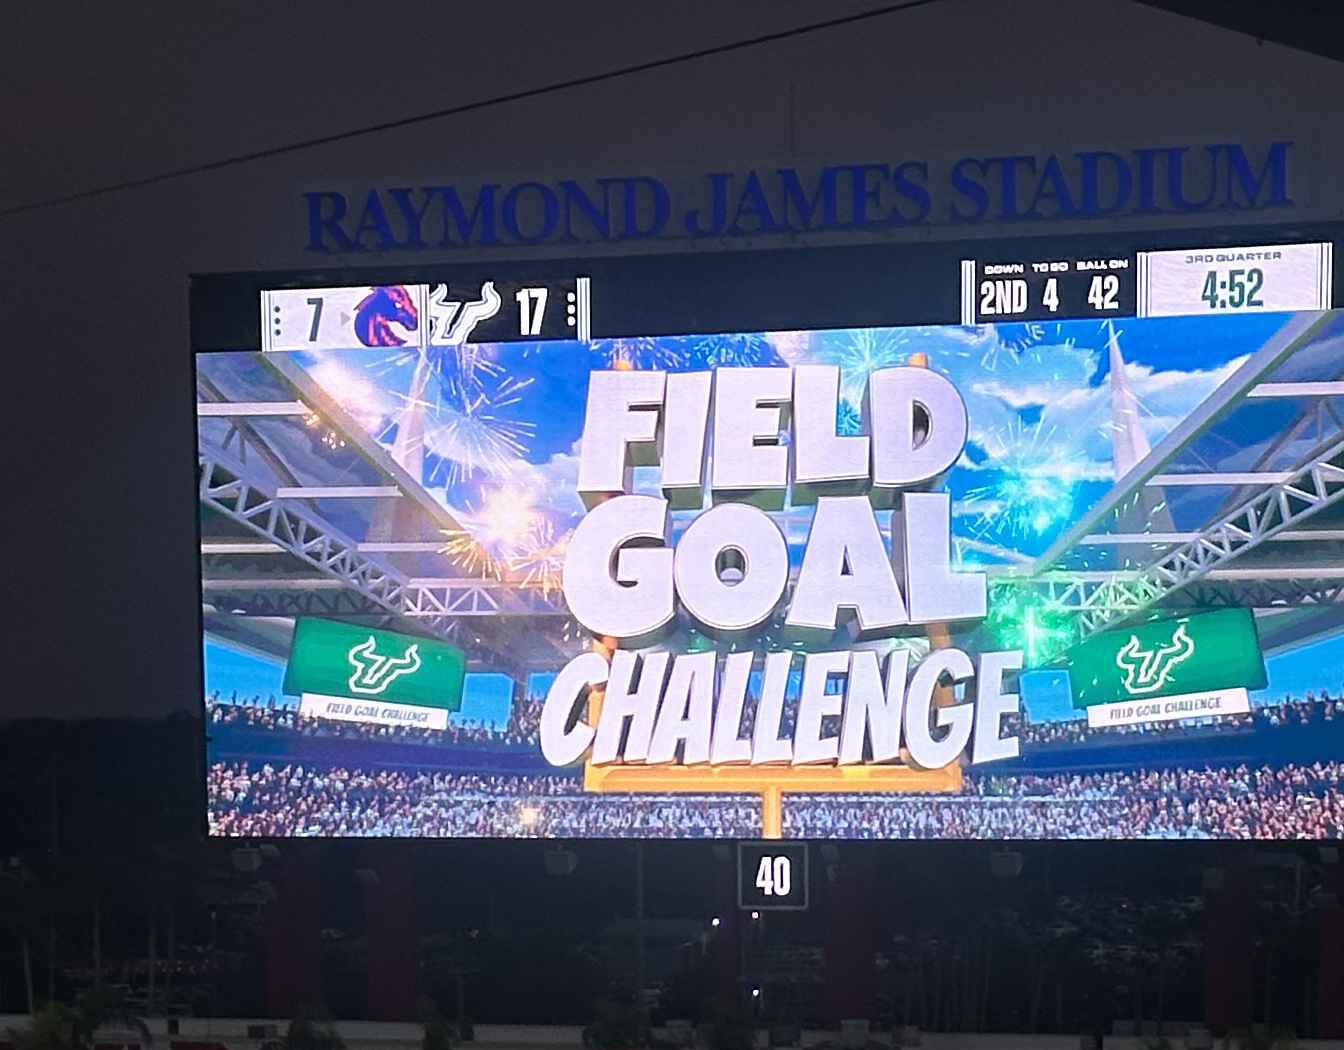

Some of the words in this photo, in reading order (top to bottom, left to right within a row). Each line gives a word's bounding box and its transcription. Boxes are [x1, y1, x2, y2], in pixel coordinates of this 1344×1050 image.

[302, 175, 671, 253] RAYMOND
[686, 163, 930, 238] JAMES
[948, 141, 1295, 225] STADIUM
[984, 263, 1024, 274] DOWN
[1185, 255, 1214, 265] 3RD
[1216, 251, 1282, 263] QUARTER
[980, 280, 1027, 315] 2ND
[1042, 278, 1059, 312] 4
[1087, 275, 1119, 310] 42
[1201, 268, 1265, 309] 4:52
[307, 298, 324, 342] 7
[516, 287, 548, 336] 17
[577, 364, 968, 507] FIELD
[563, 491, 988, 644] GOAL
[381, 707, 431, 723] CHALLENGE
[540, 648, 1024, 770] CHALLENGE
[1165, 696, 1222, 714] CHALLENGE
[756, 856, 791, 896] 40
